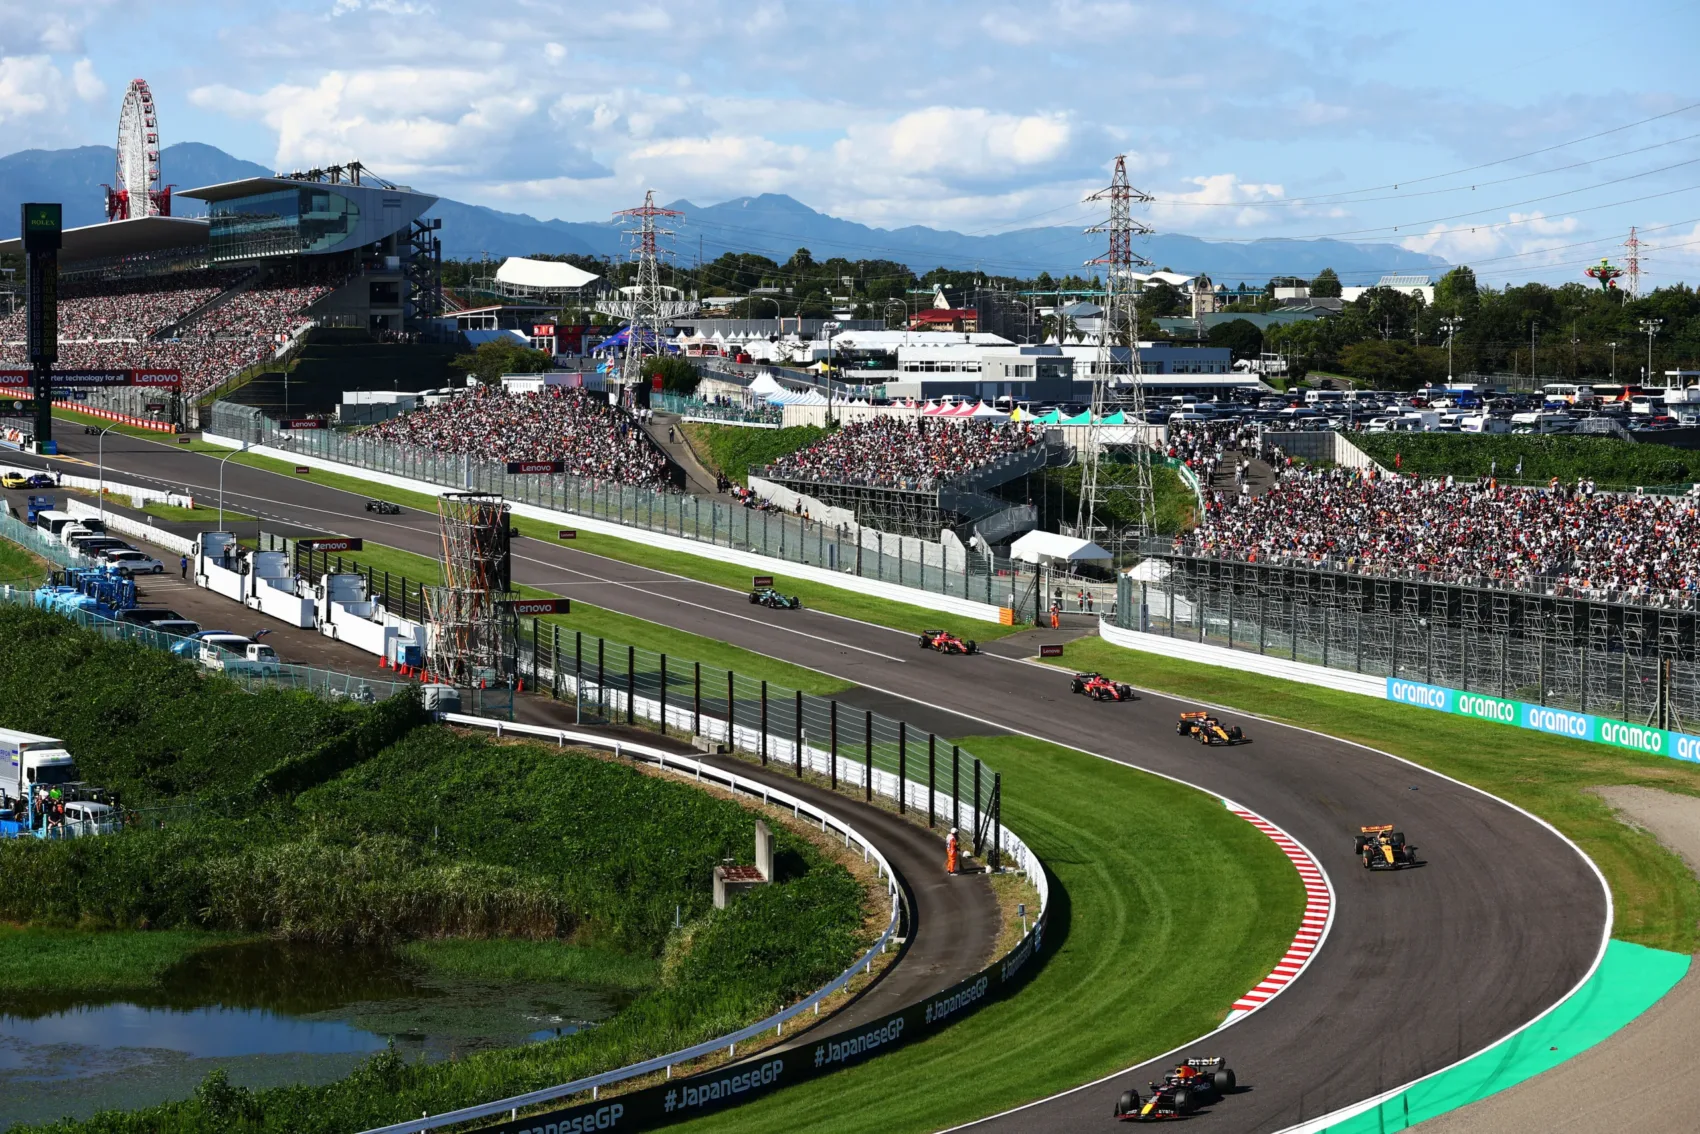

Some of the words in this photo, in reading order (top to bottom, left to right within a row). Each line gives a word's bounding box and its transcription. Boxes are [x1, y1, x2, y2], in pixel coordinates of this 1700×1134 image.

[135, 373, 178, 382] Lenovo
[1392, 682, 1445, 708] aramco
[1459, 695, 1514, 722] aramco
[1529, 708, 1586, 736] aramco
[1602, 722, 1661, 752] aramco
[925, 976, 988, 1024] #JapaneseGP
[814, 1017, 905, 1067] #JapaneseGP
[664, 1059, 784, 1112] #JapaneseGP
